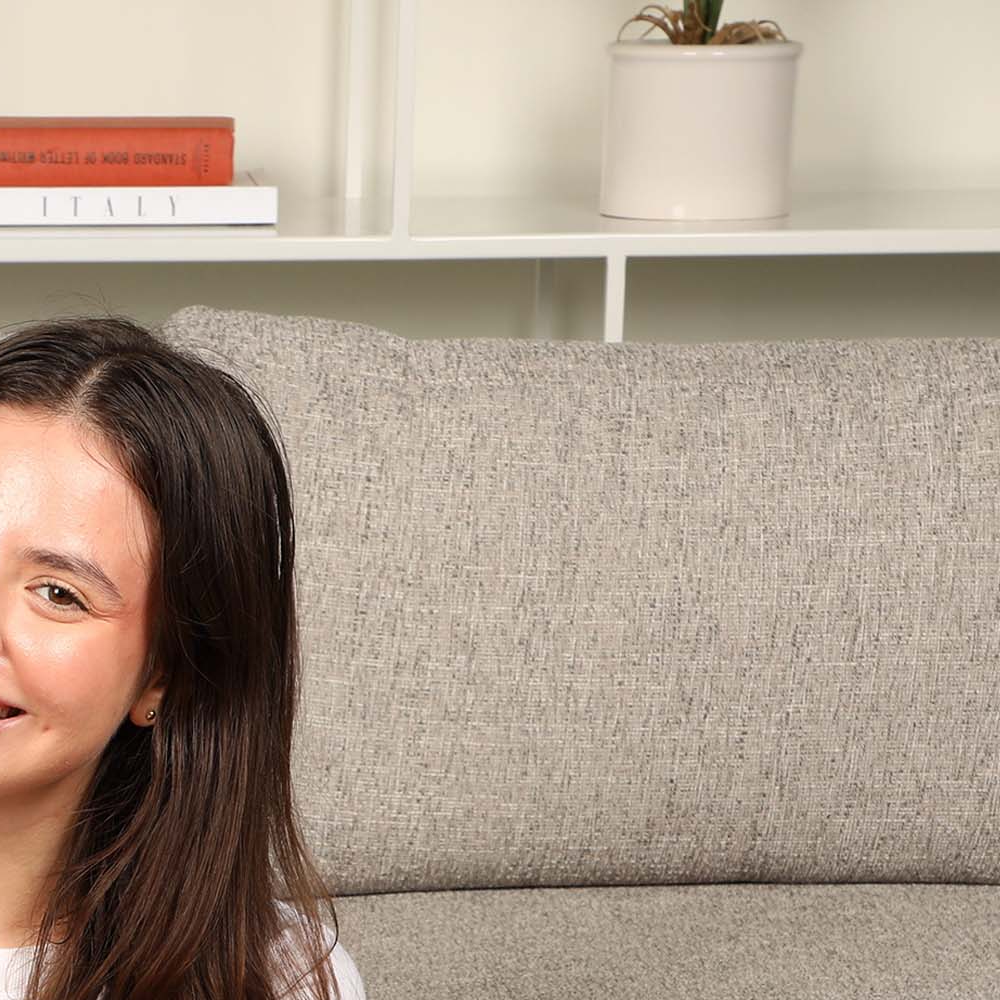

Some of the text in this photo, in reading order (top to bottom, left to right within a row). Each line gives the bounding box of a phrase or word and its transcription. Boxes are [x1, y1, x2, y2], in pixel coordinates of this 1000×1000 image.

[39, 150, 80, 166] LETTER
[82, 151, 98, 166] OF
[102, 151, 129, 166] BOOK
[133, 151, 188, 167] STANDARD
[41, 195, 179, 217] ITALY
